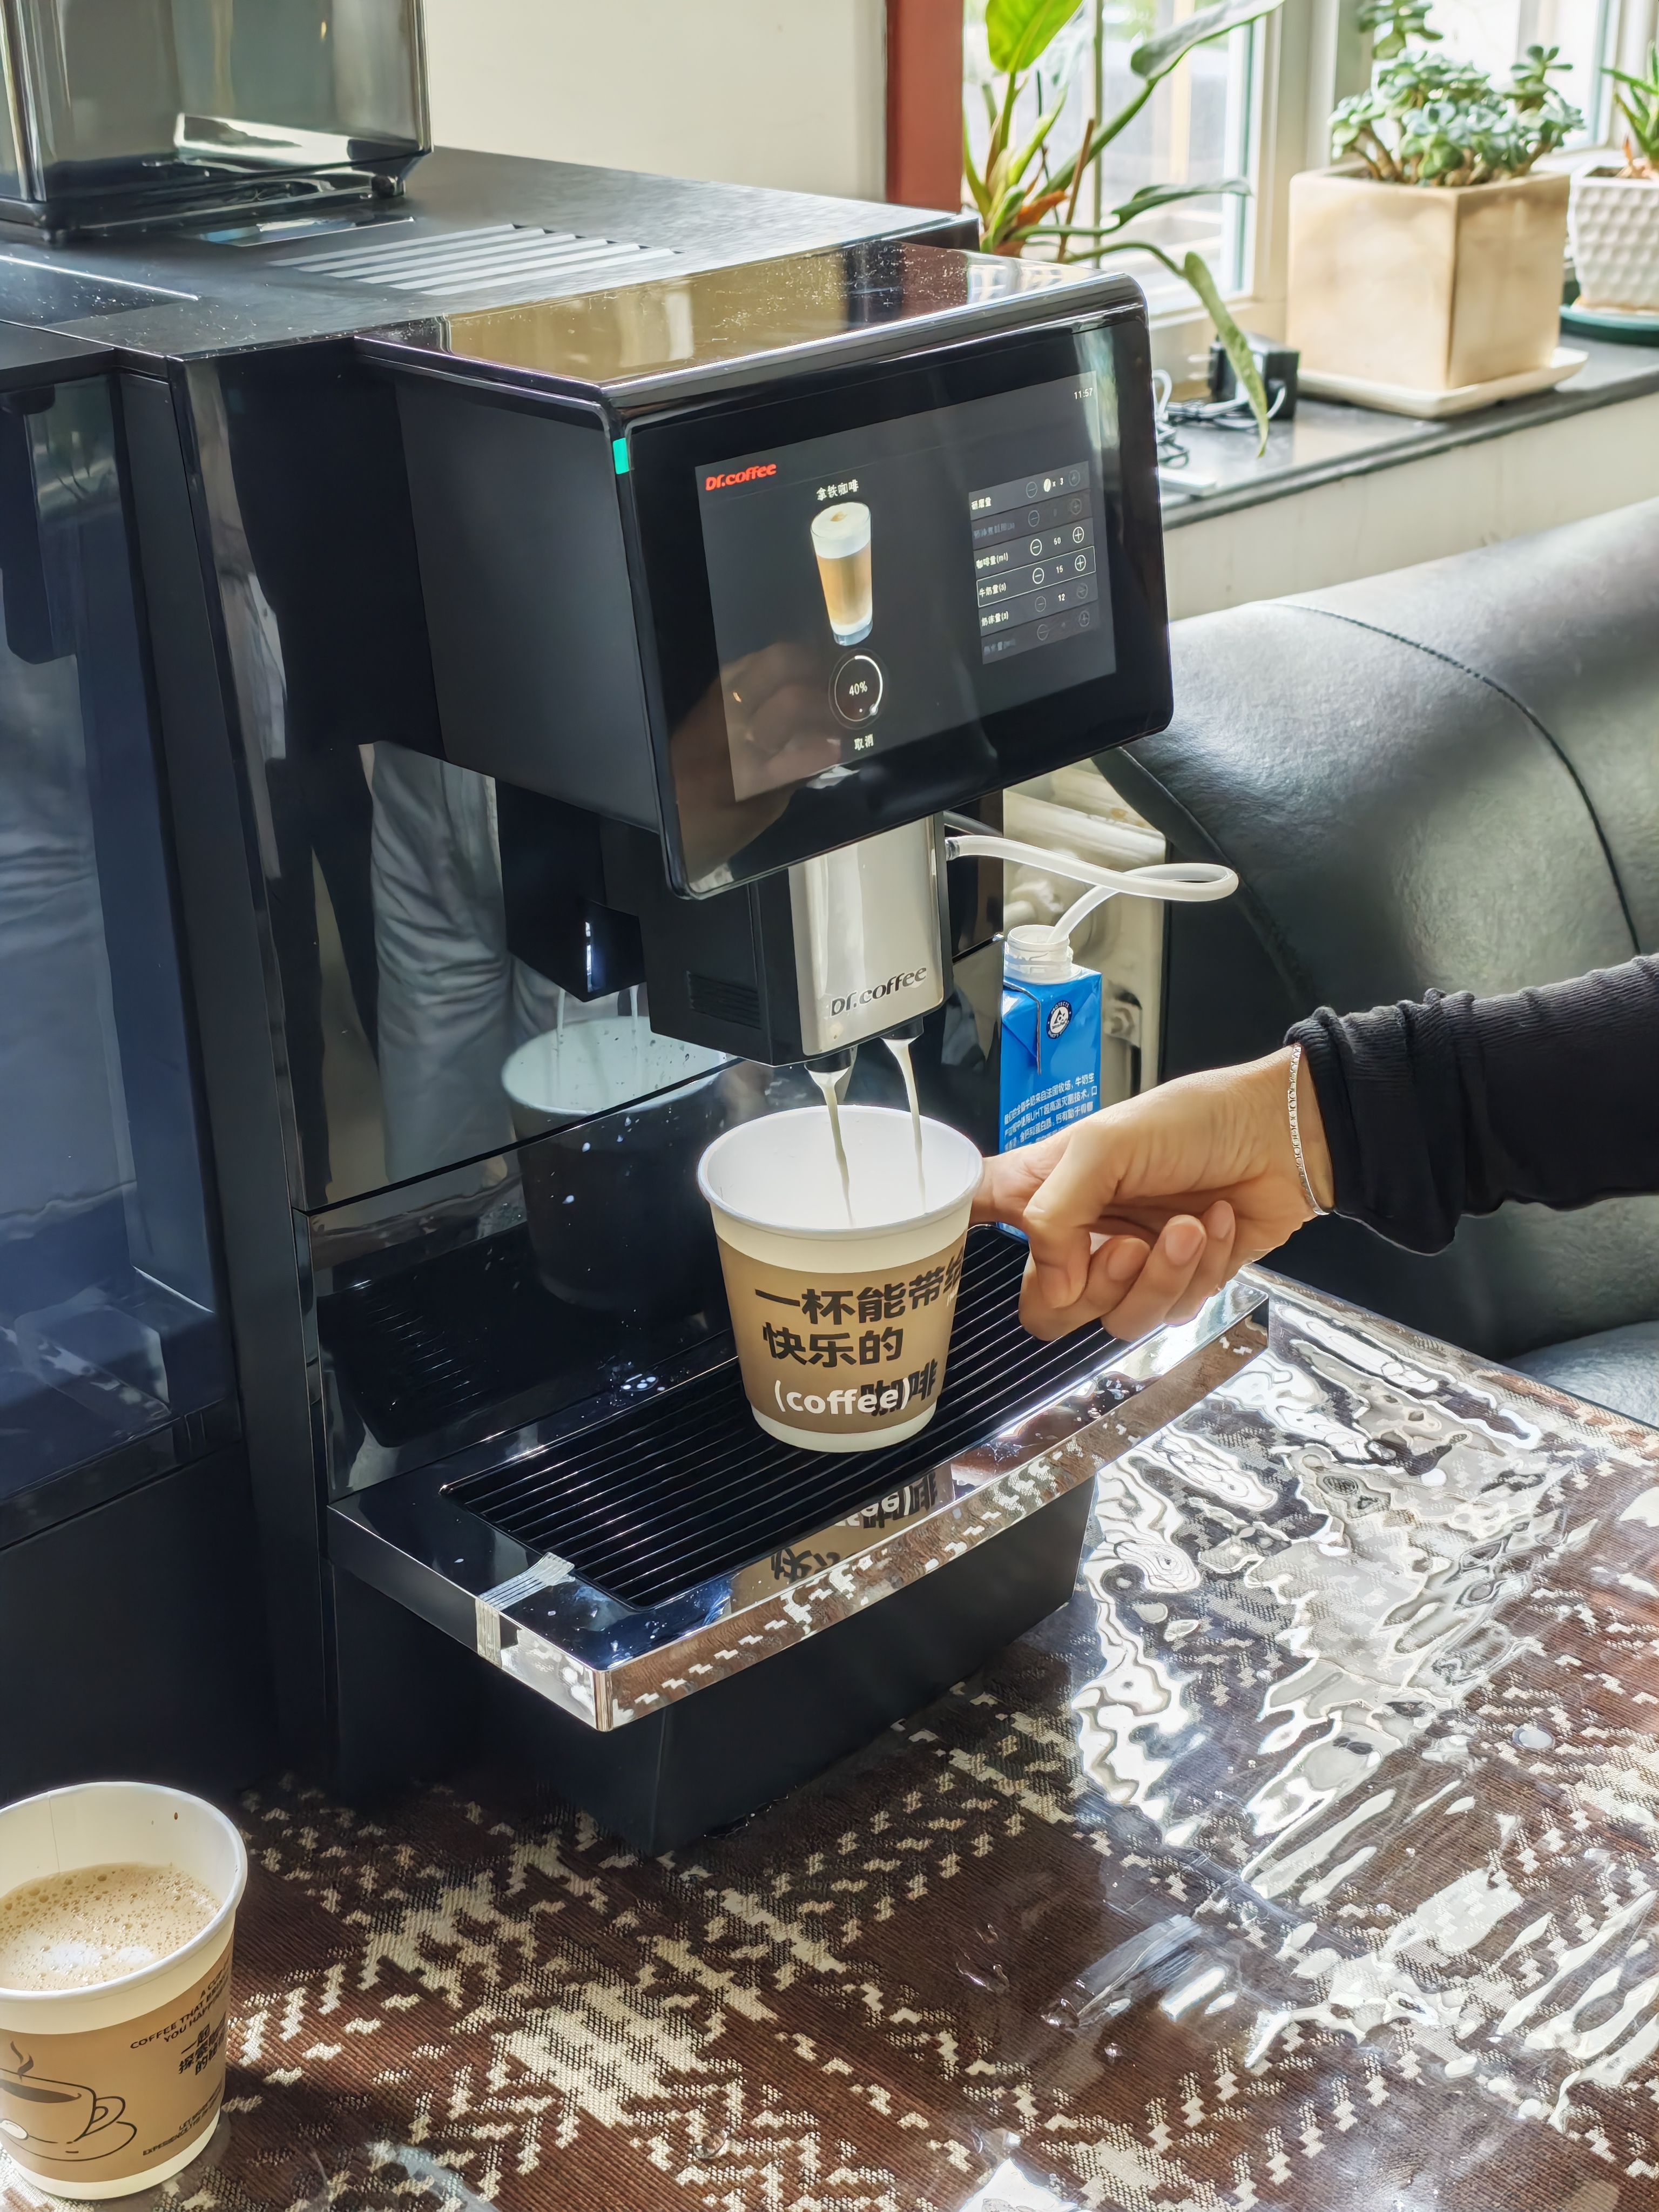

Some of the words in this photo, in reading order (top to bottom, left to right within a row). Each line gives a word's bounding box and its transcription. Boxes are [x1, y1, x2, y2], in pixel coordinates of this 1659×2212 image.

[1074, 387, 1092, 400] 11:57
[705, 463, 777, 491] Dr.coffee
[816, 478, 859, 501] 拿铁咖啡
[1056, 565, 1063, 574] 15
[1058, 594, 1065, 602] 12
[849, 680, 867, 696] 40%
[854, 733, 874, 751] 取消
[831, 967, 927, 1016] Dr.coffee
[755, 1245, 963, 1325] 一杯能带给
[763, 1322, 903, 1368] 快乐的
[774, 1378, 910, 1415] (coffee)
[130, 2021, 177, 2049] COFFEE
[179, 2000, 204, 2024] THAT
[164, 2024, 187, 2042] YOU
